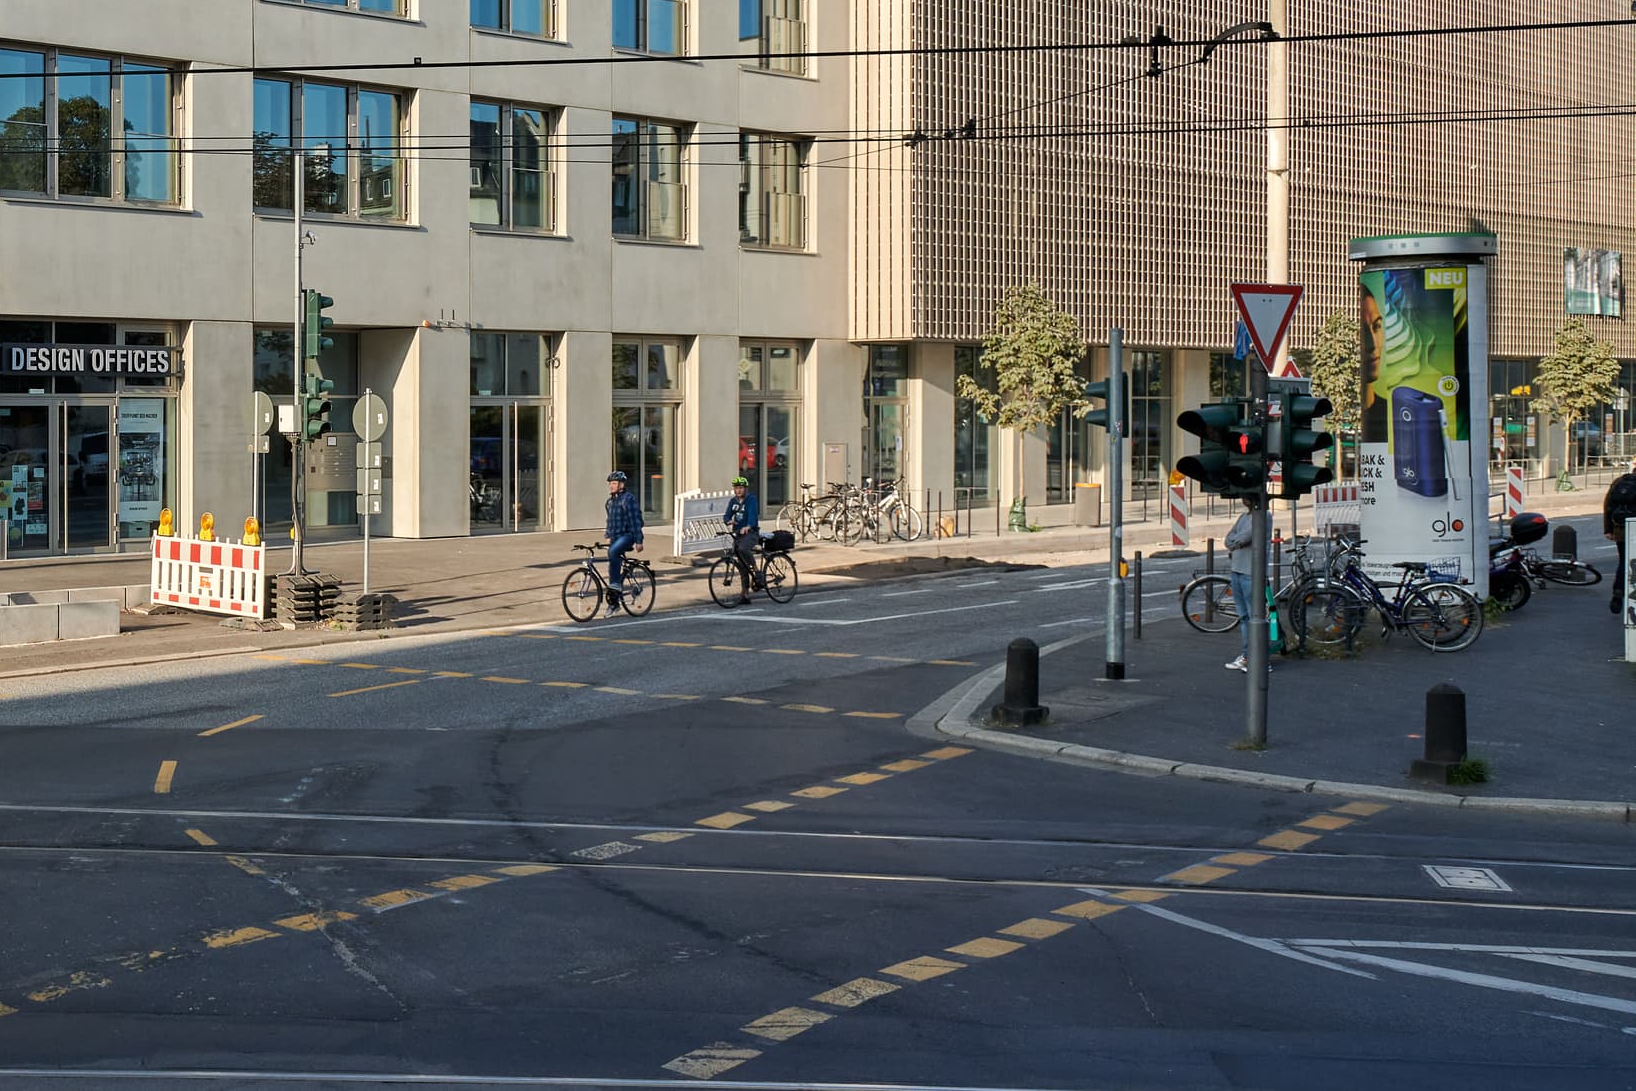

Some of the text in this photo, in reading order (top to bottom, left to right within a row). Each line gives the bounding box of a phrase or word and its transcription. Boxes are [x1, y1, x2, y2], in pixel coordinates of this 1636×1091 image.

[1428, 271, 1463, 286] NEU
[11, 347, 169, 373] DESIGN OFFICES
[1431, 510, 1465, 538] glo
